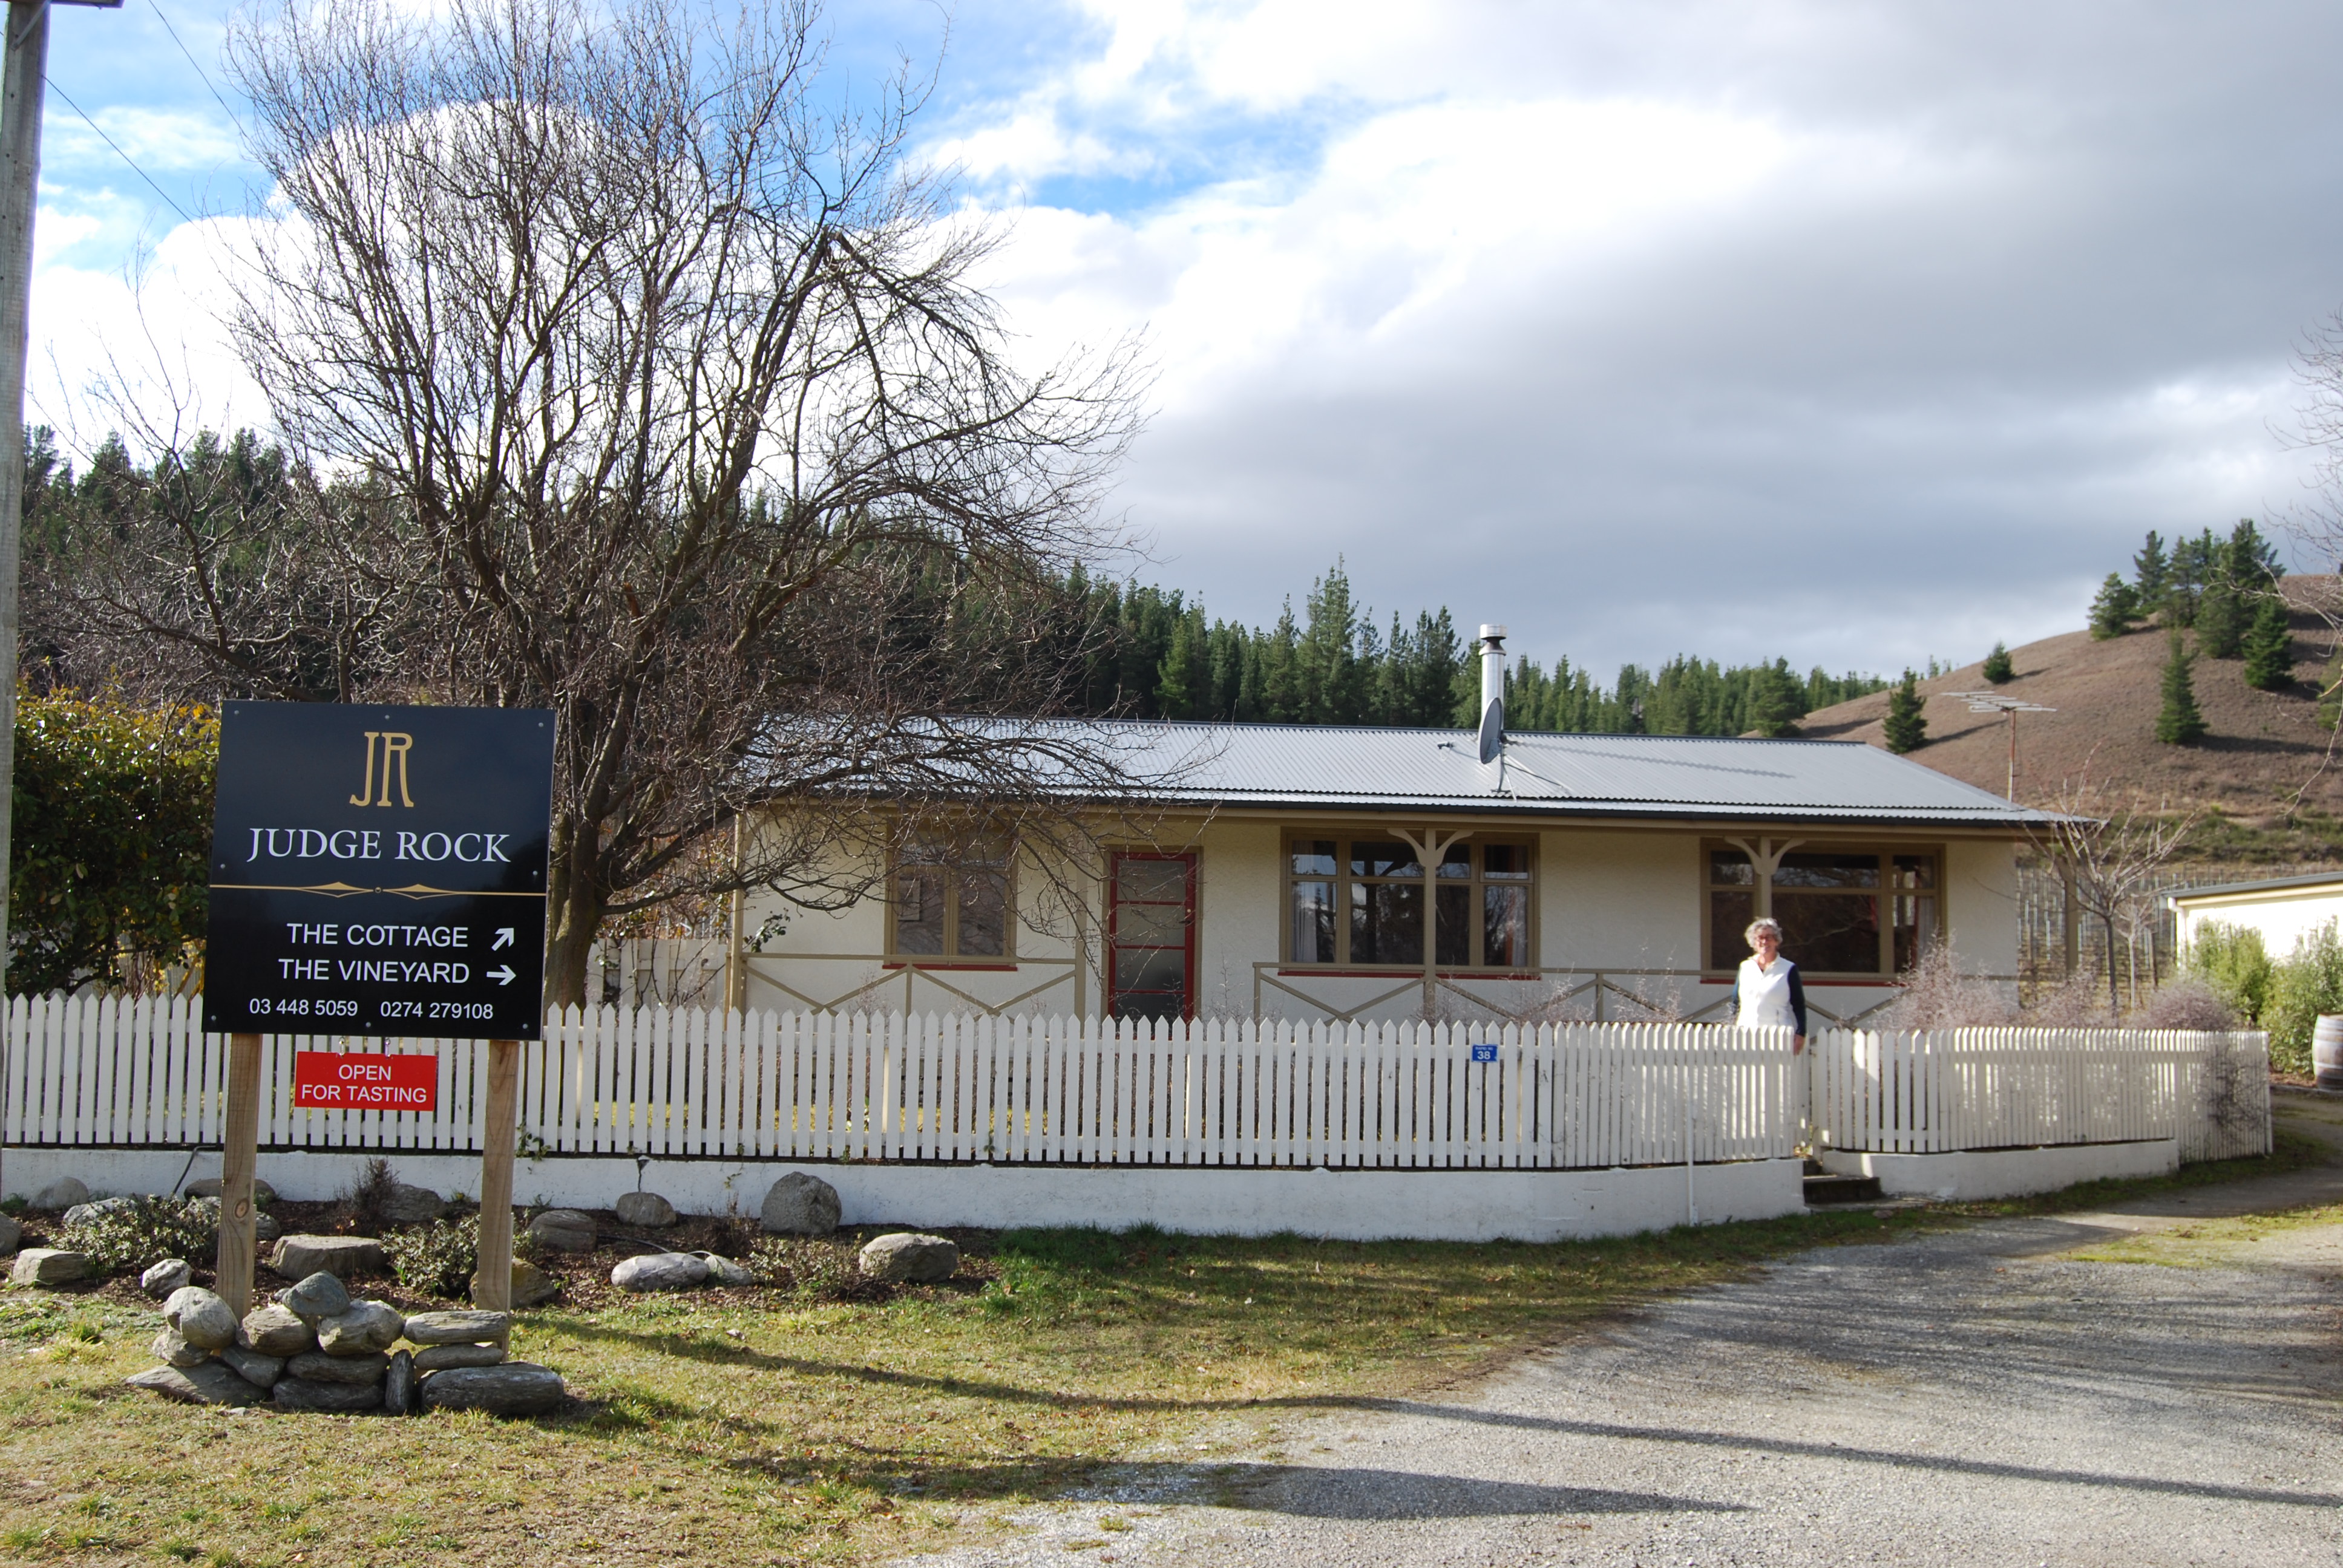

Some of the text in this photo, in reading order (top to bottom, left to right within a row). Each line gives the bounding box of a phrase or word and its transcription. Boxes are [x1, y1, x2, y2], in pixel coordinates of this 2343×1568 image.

[349, 731, 414, 808] JR
[246, 828, 511, 862] JUDGE ROCK
[286, 923, 468, 947] THE COTTAGE
[278, 958, 470, 983] THE VINEYARD
[249, 998, 493, 1019] 03 448 5059 0274 279108
[1477, 1051, 1491, 1060] 38
[338, 1064, 392, 1081] OPEN
[302, 1084, 427, 1103] FOR TASTING
